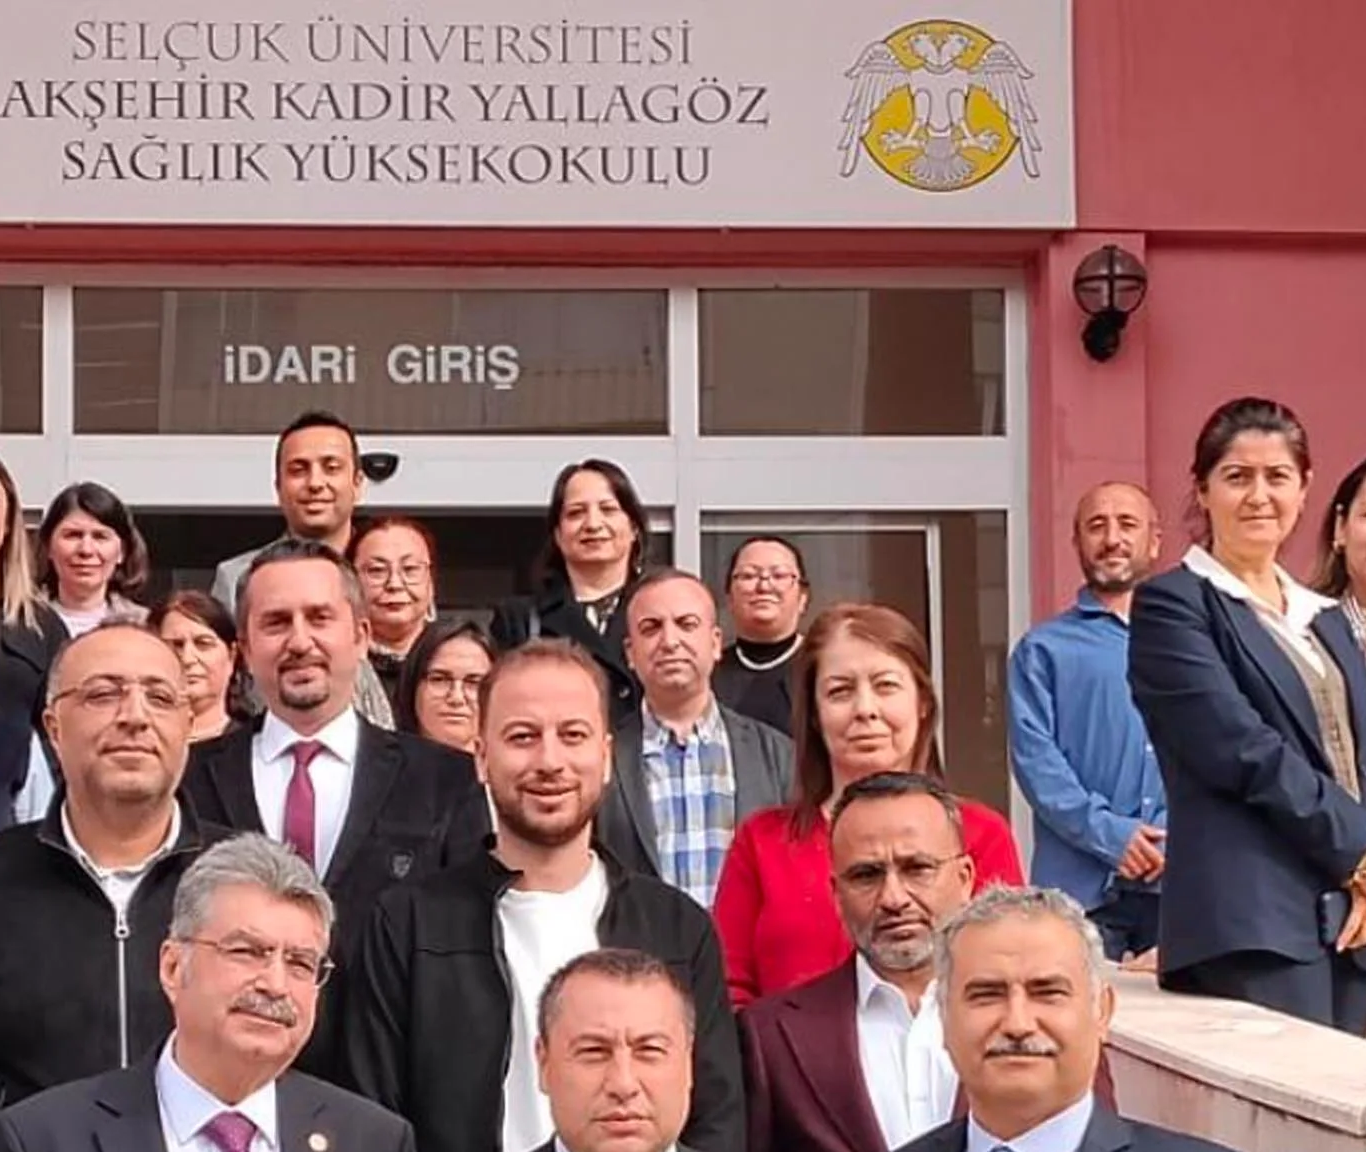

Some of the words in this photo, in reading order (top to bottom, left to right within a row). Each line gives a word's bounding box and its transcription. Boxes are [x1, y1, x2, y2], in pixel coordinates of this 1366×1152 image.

[72, 20, 289, 71] SELÇUK
[306, 15, 695, 65] ÜNİVERSİTESİ
[271, 75, 457, 123] KADİR
[469, 77, 770, 127] YALLAGÖZ
[62, 134, 271, 185] SAĞLIK
[282, 135, 715, 188] YÜKSEKOKULU
